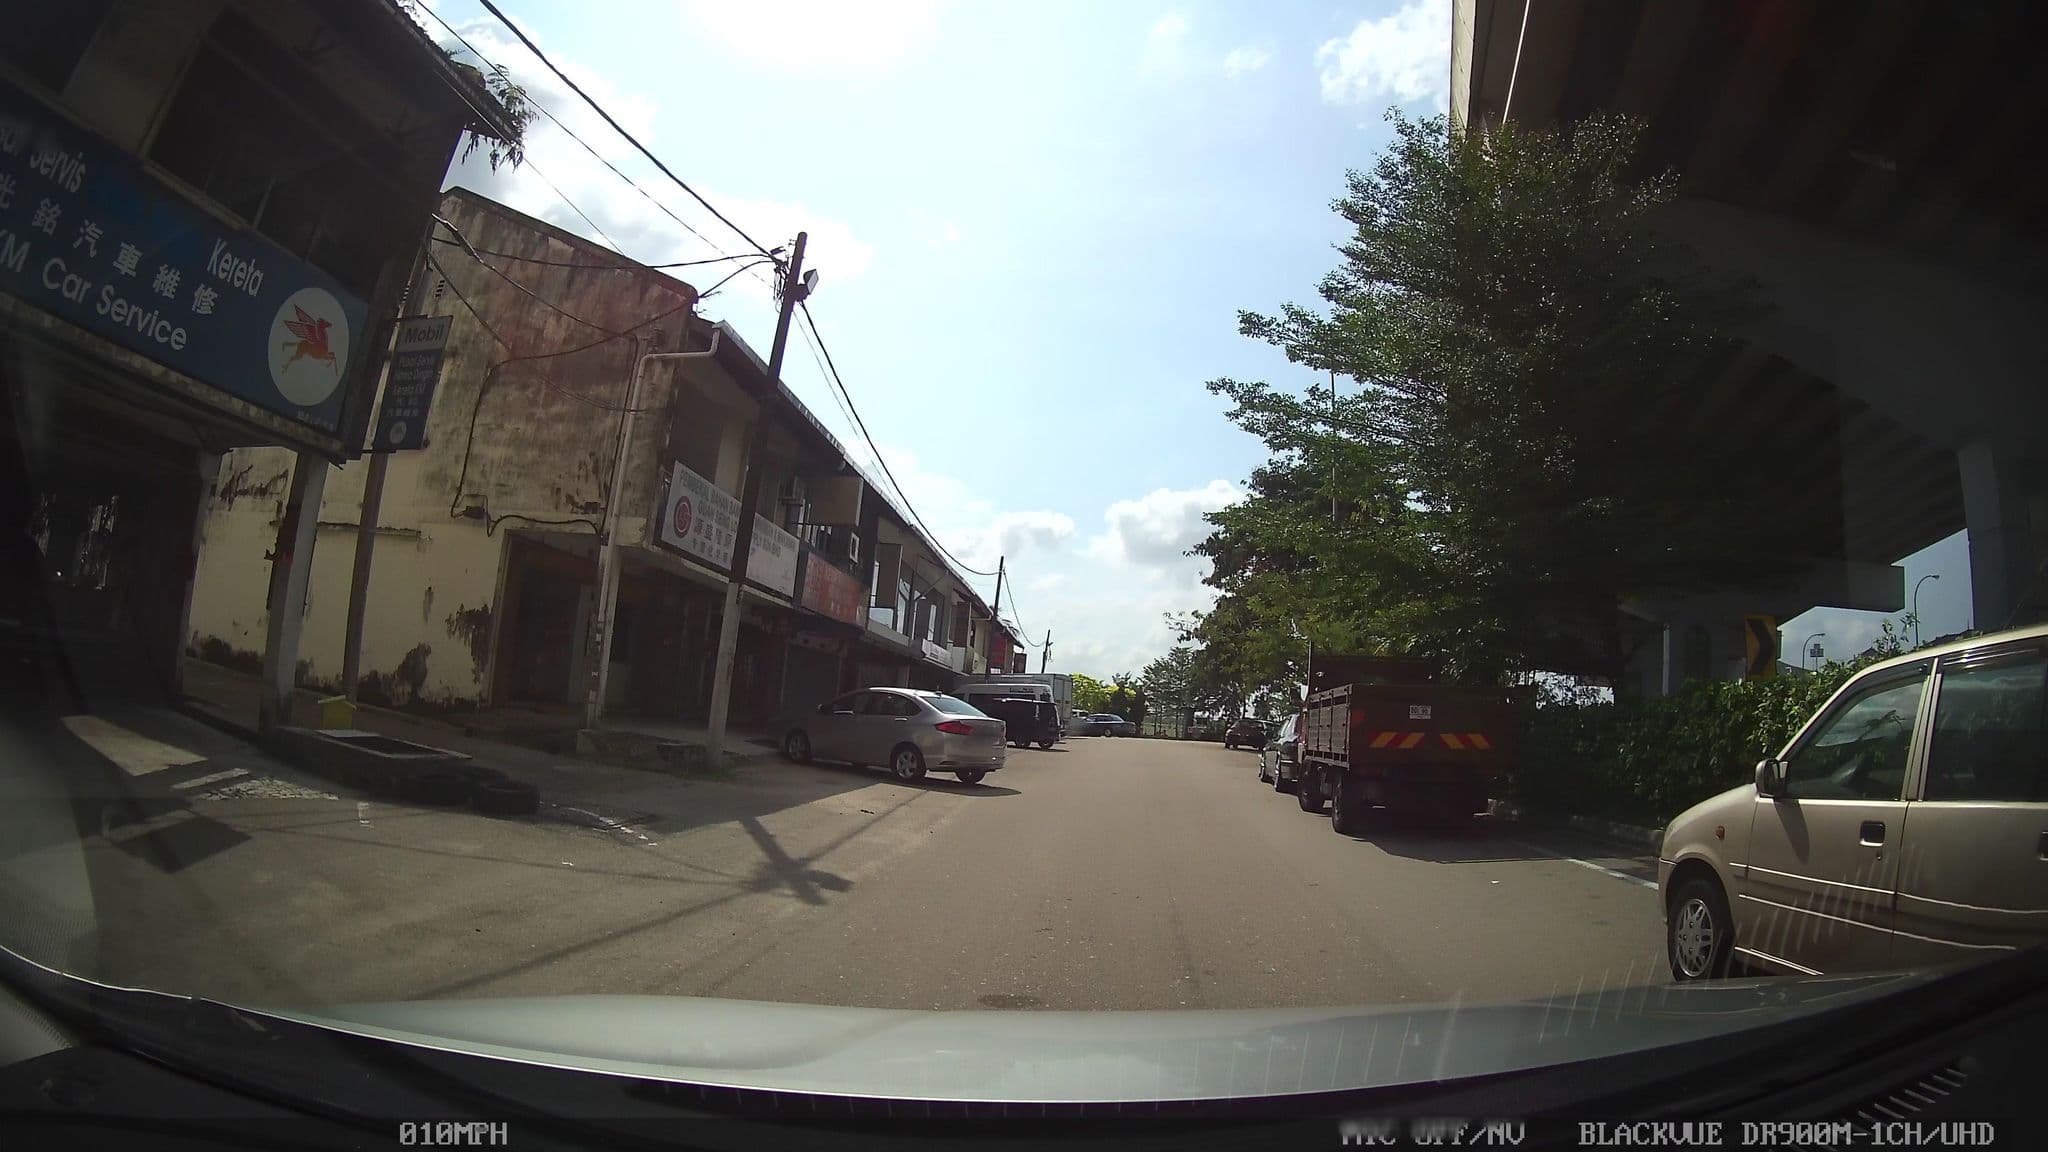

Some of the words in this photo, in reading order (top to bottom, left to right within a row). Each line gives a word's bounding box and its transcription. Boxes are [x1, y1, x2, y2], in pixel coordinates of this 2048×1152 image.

[0, 228, 31, 274] M
[42, 257, 92, 304] Car
[96, 284, 188, 351] Service
[207, 238, 264, 297] Kereta
[405, 323, 444, 344] Mobil
